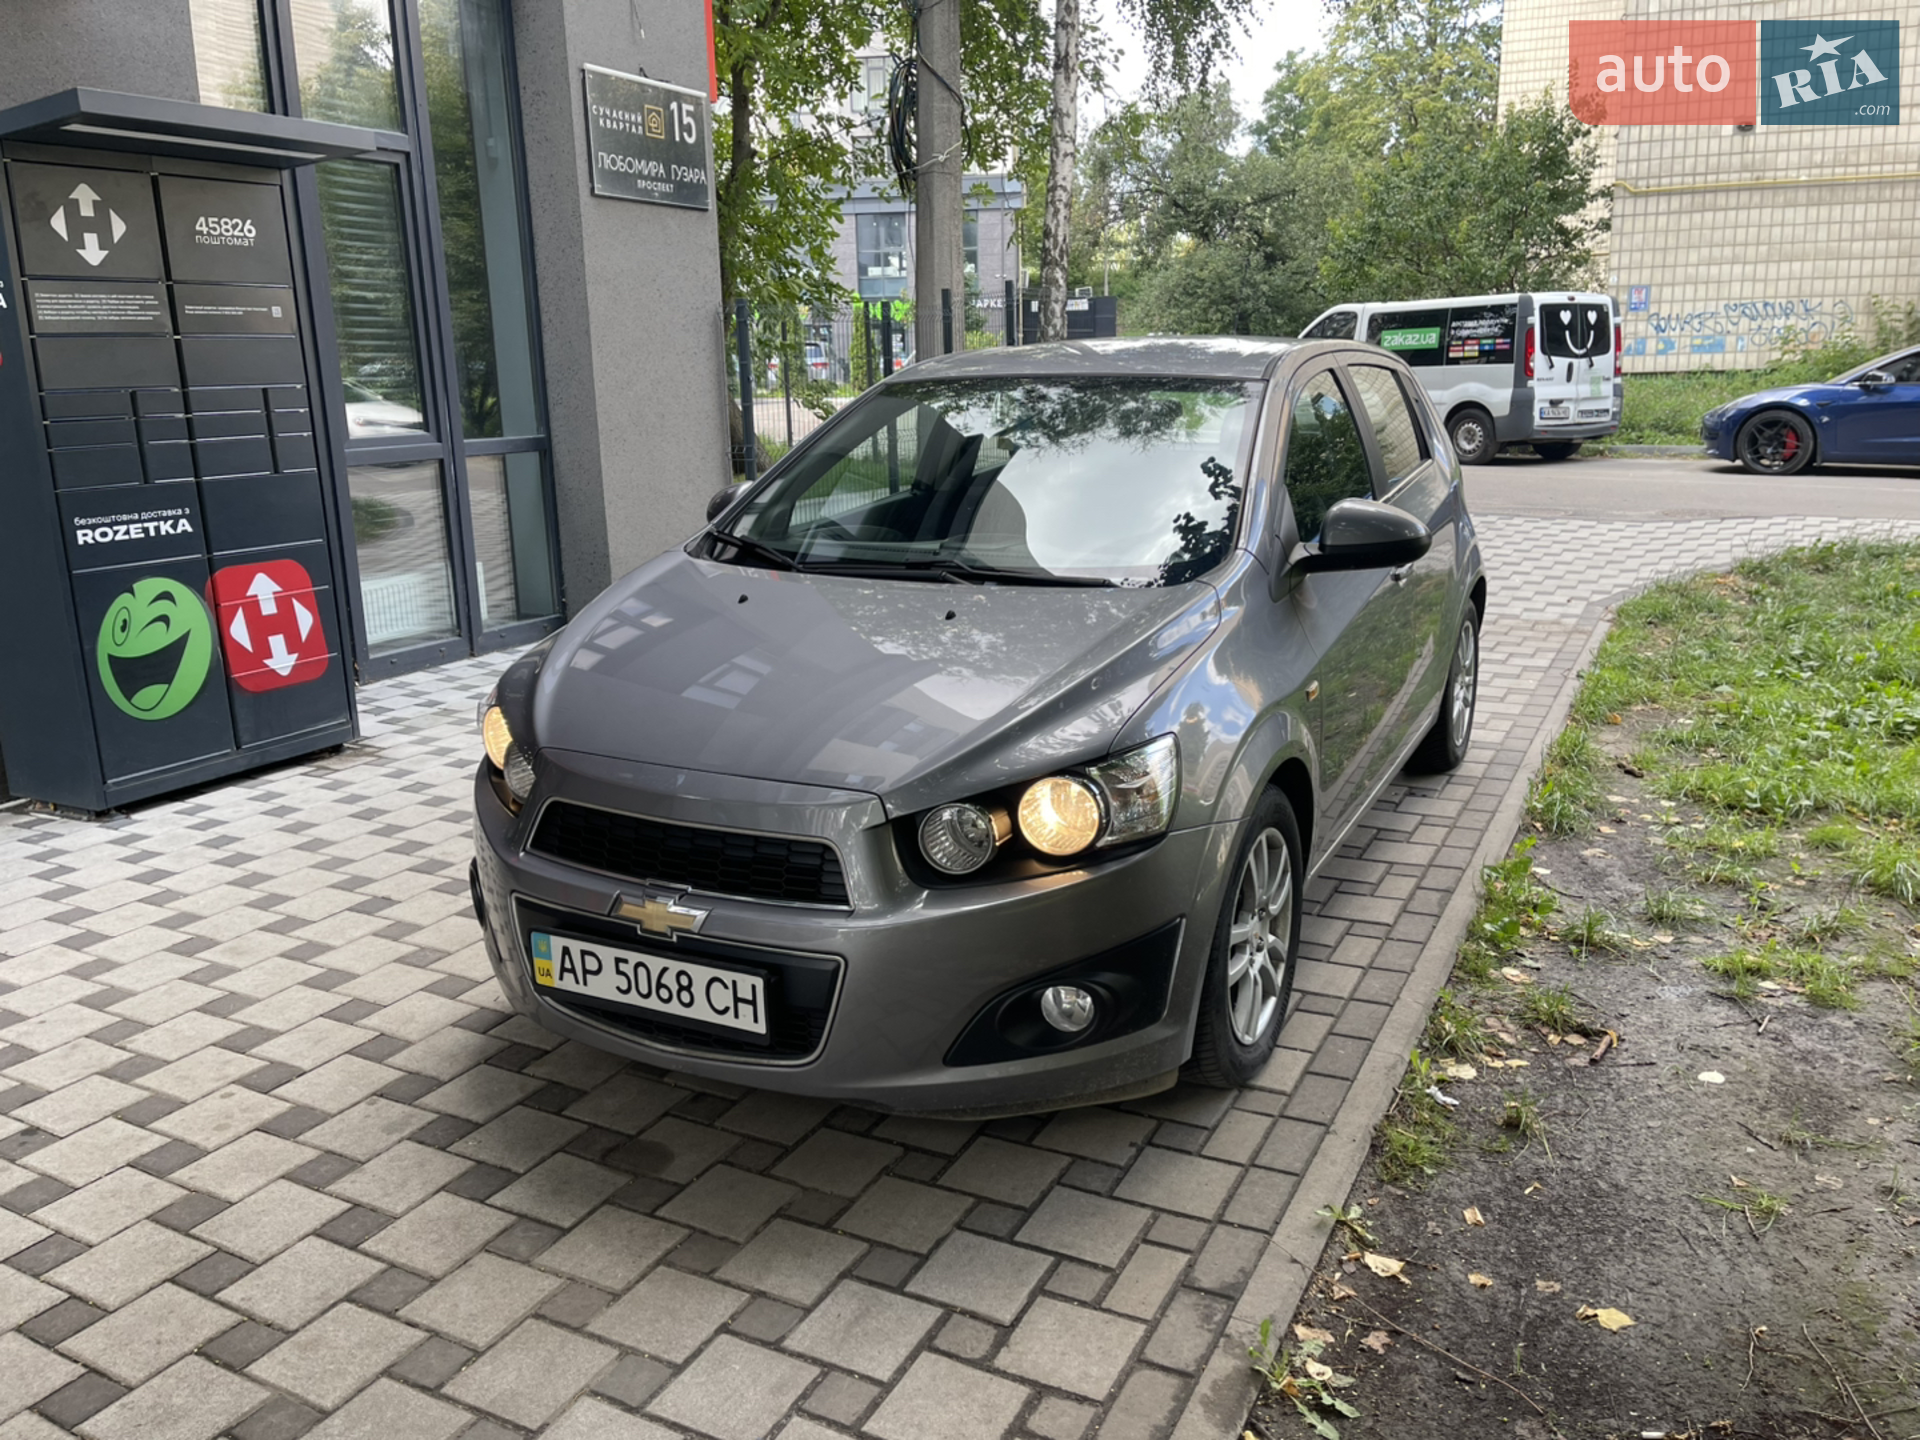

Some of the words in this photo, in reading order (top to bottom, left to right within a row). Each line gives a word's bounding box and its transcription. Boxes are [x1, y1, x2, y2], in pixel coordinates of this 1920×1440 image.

[591, 104, 643, 124] СУЧАСНИЙ
[670, 101, 697, 144] 15
[599, 117, 644, 135] КВАРТАЛ
[598, 152, 666, 179] ЛЮБОМИРА
[671, 164, 708, 185] ГУЗАРА
[636, 179, 674, 193] ПРОСПЕКТ
[195, 216, 257, 238] 45826
[1383, 331, 1437, 348] zakaz.ua
[73, 512, 139, 526] безкоштовна
[140, 507, 183, 520] доставка
[76, 518, 194, 546] ROZETKA
[537, 966, 553, 979] UA
[558, 945, 604, 987] AP
[614, 956, 696, 1009] 5068
[705, 976, 759, 1025] CH
